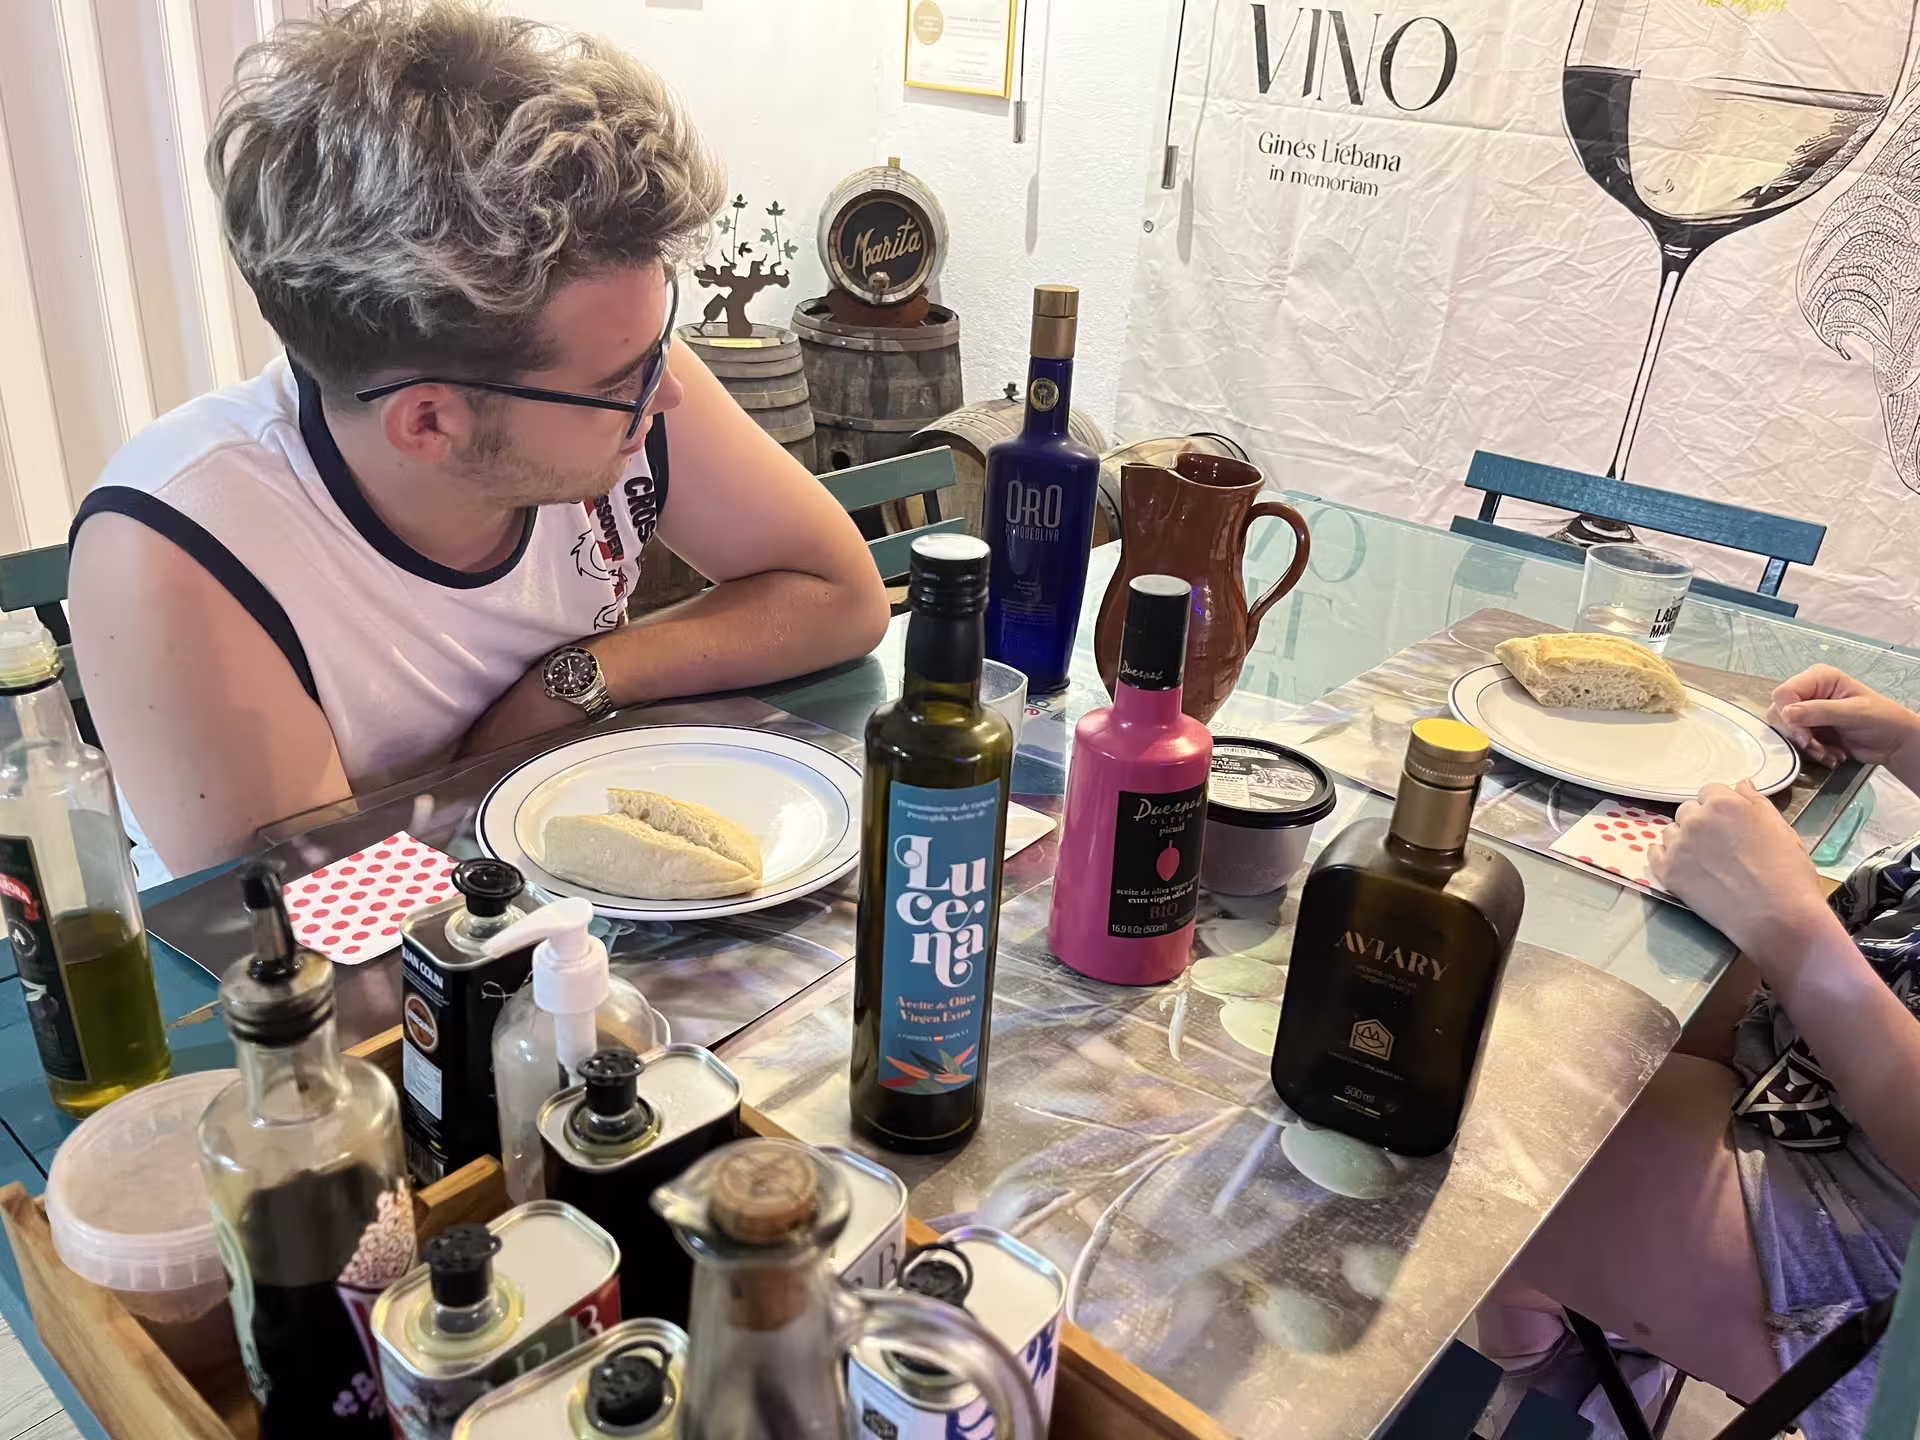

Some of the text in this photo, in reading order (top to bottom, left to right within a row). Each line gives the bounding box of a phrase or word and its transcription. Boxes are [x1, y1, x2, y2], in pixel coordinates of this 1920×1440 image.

[1250, 3, 1458, 112] VINO
[1258, 131, 1402, 172] Ginés Liébana
[1269, 165, 1379, 197] in memoriam
[844, 217, 922, 279] Marita
[623, 476, 656, 548] CROS
[1006, 480, 1063, 529] ORO
[1159, 822, 1185, 837] picual
[1116, 887, 1139, 896] aceite
[1140, 888, 1151, 896] de
[1151, 887, 1170, 895] oliva
[1128, 896, 1148, 904] extra
[1150, 894, 1172, 905] virgin
[1172, 889, 1187, 900] olive
[1150, 902, 1179, 920] BIO
[1334, 930, 1449, 981] AVIARY
[1344, 1085, 1363, 1100] 500
